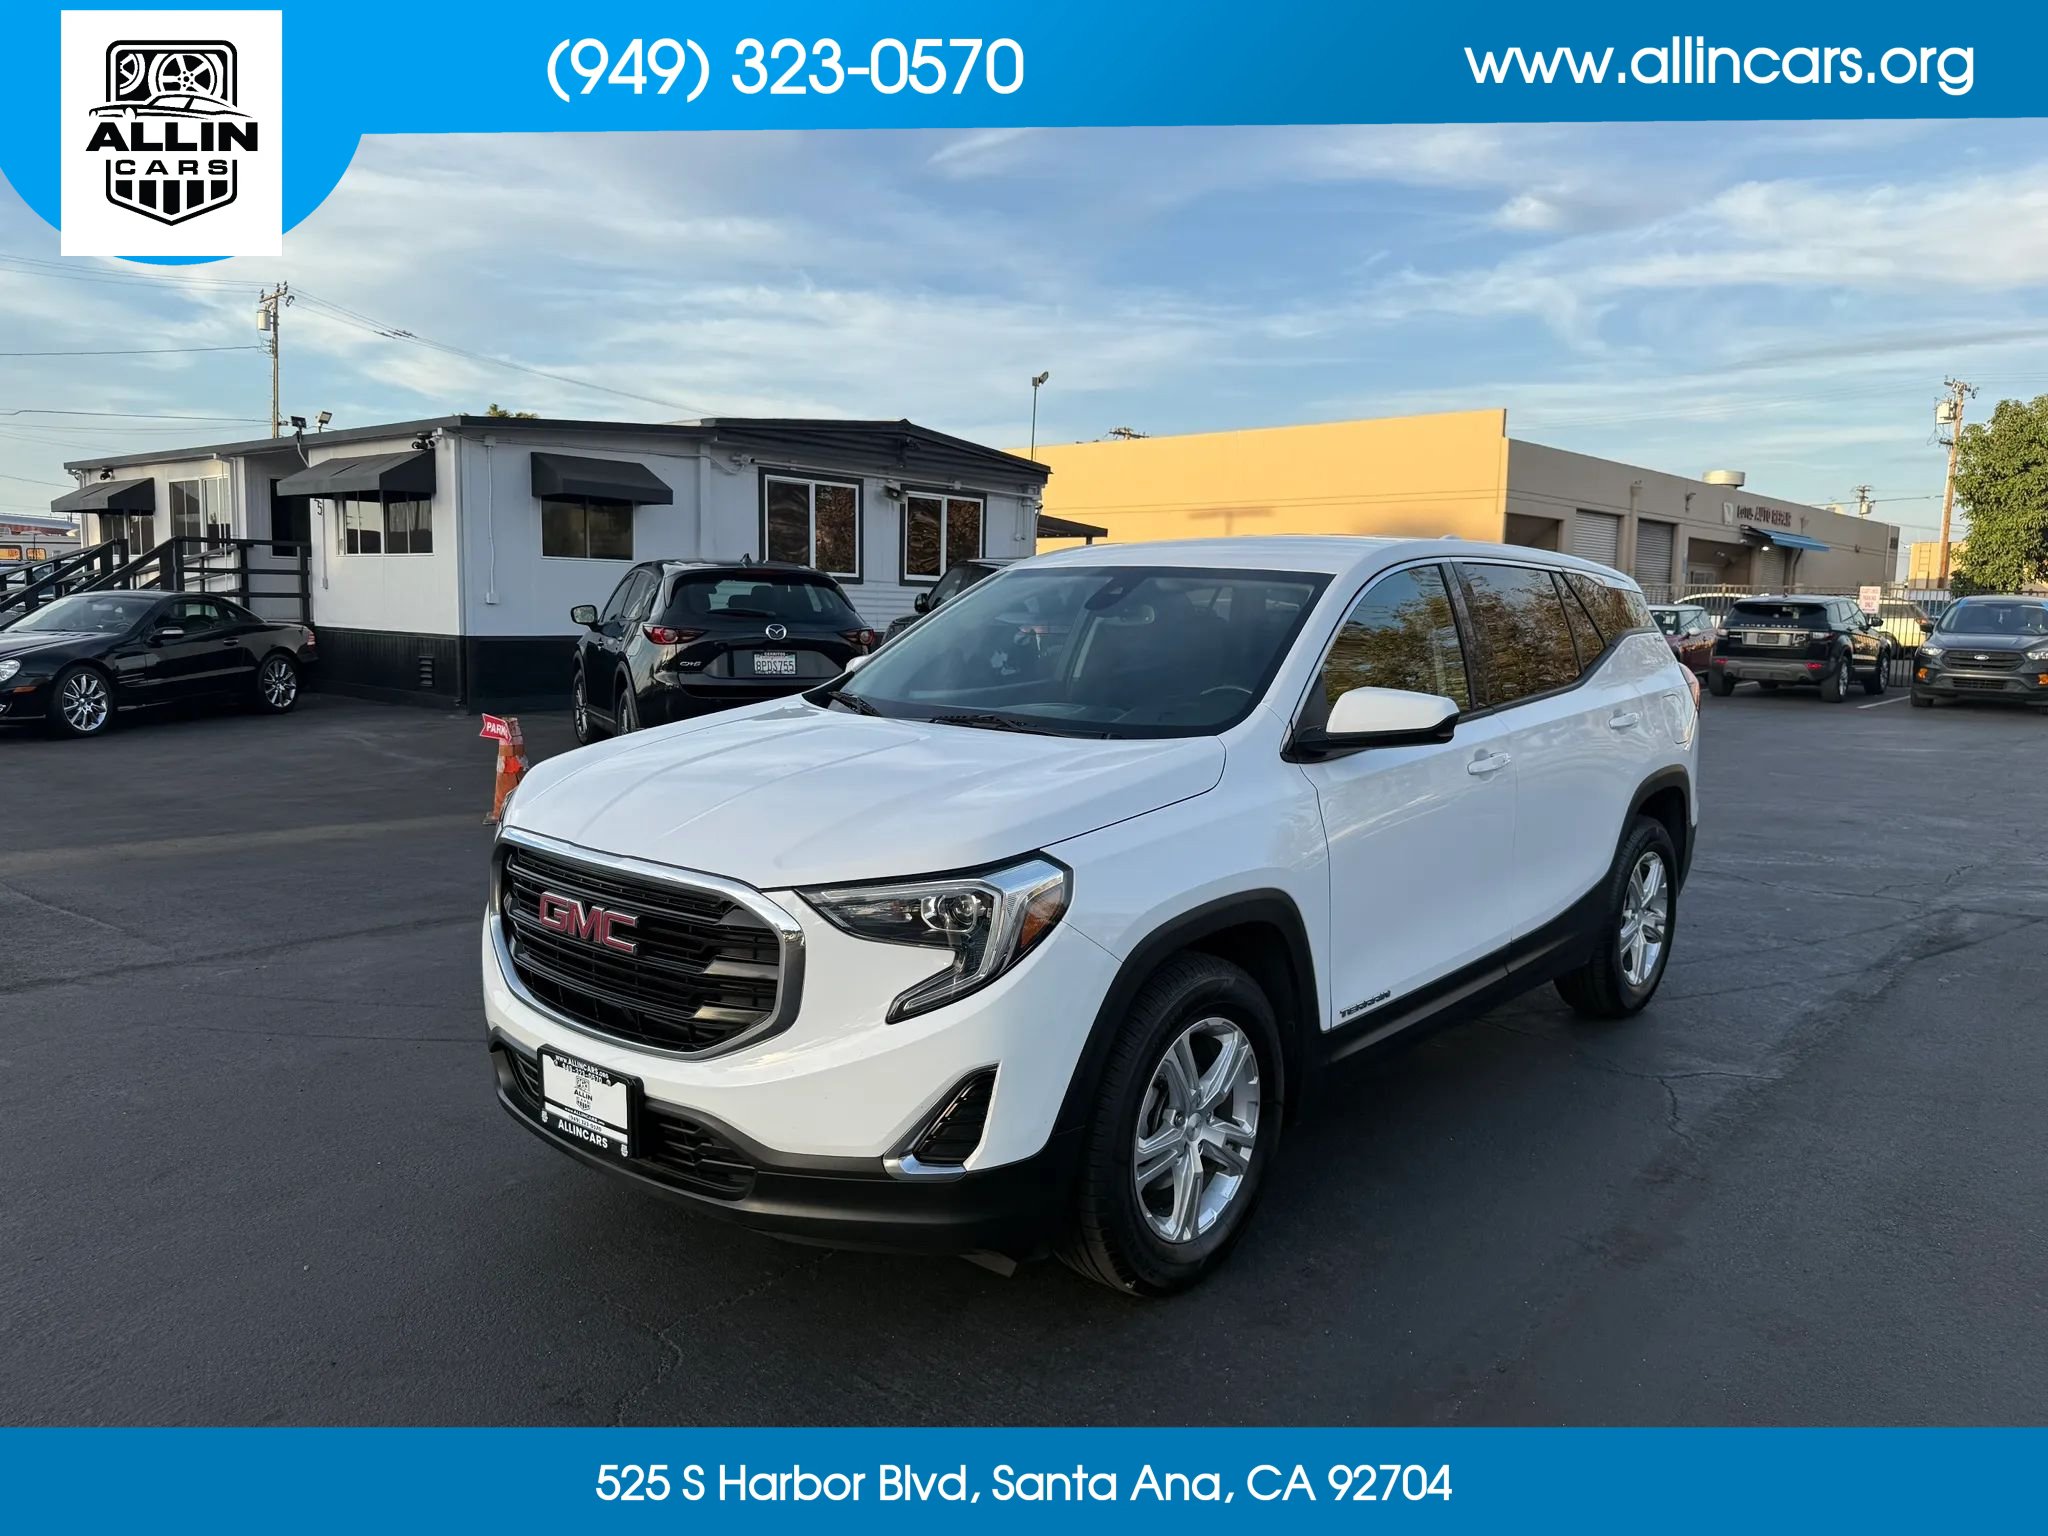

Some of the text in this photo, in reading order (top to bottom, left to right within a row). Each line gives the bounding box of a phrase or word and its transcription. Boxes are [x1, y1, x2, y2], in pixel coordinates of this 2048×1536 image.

[756, 660, 794, 673] 8PDS755
[539, 891, 638, 955] GMC
[1339, 990, 1391, 1018] TERRAIN
[574, 1089, 593, 1101] ALLIN
[558, 1119, 609, 1149] ALLINCARS
